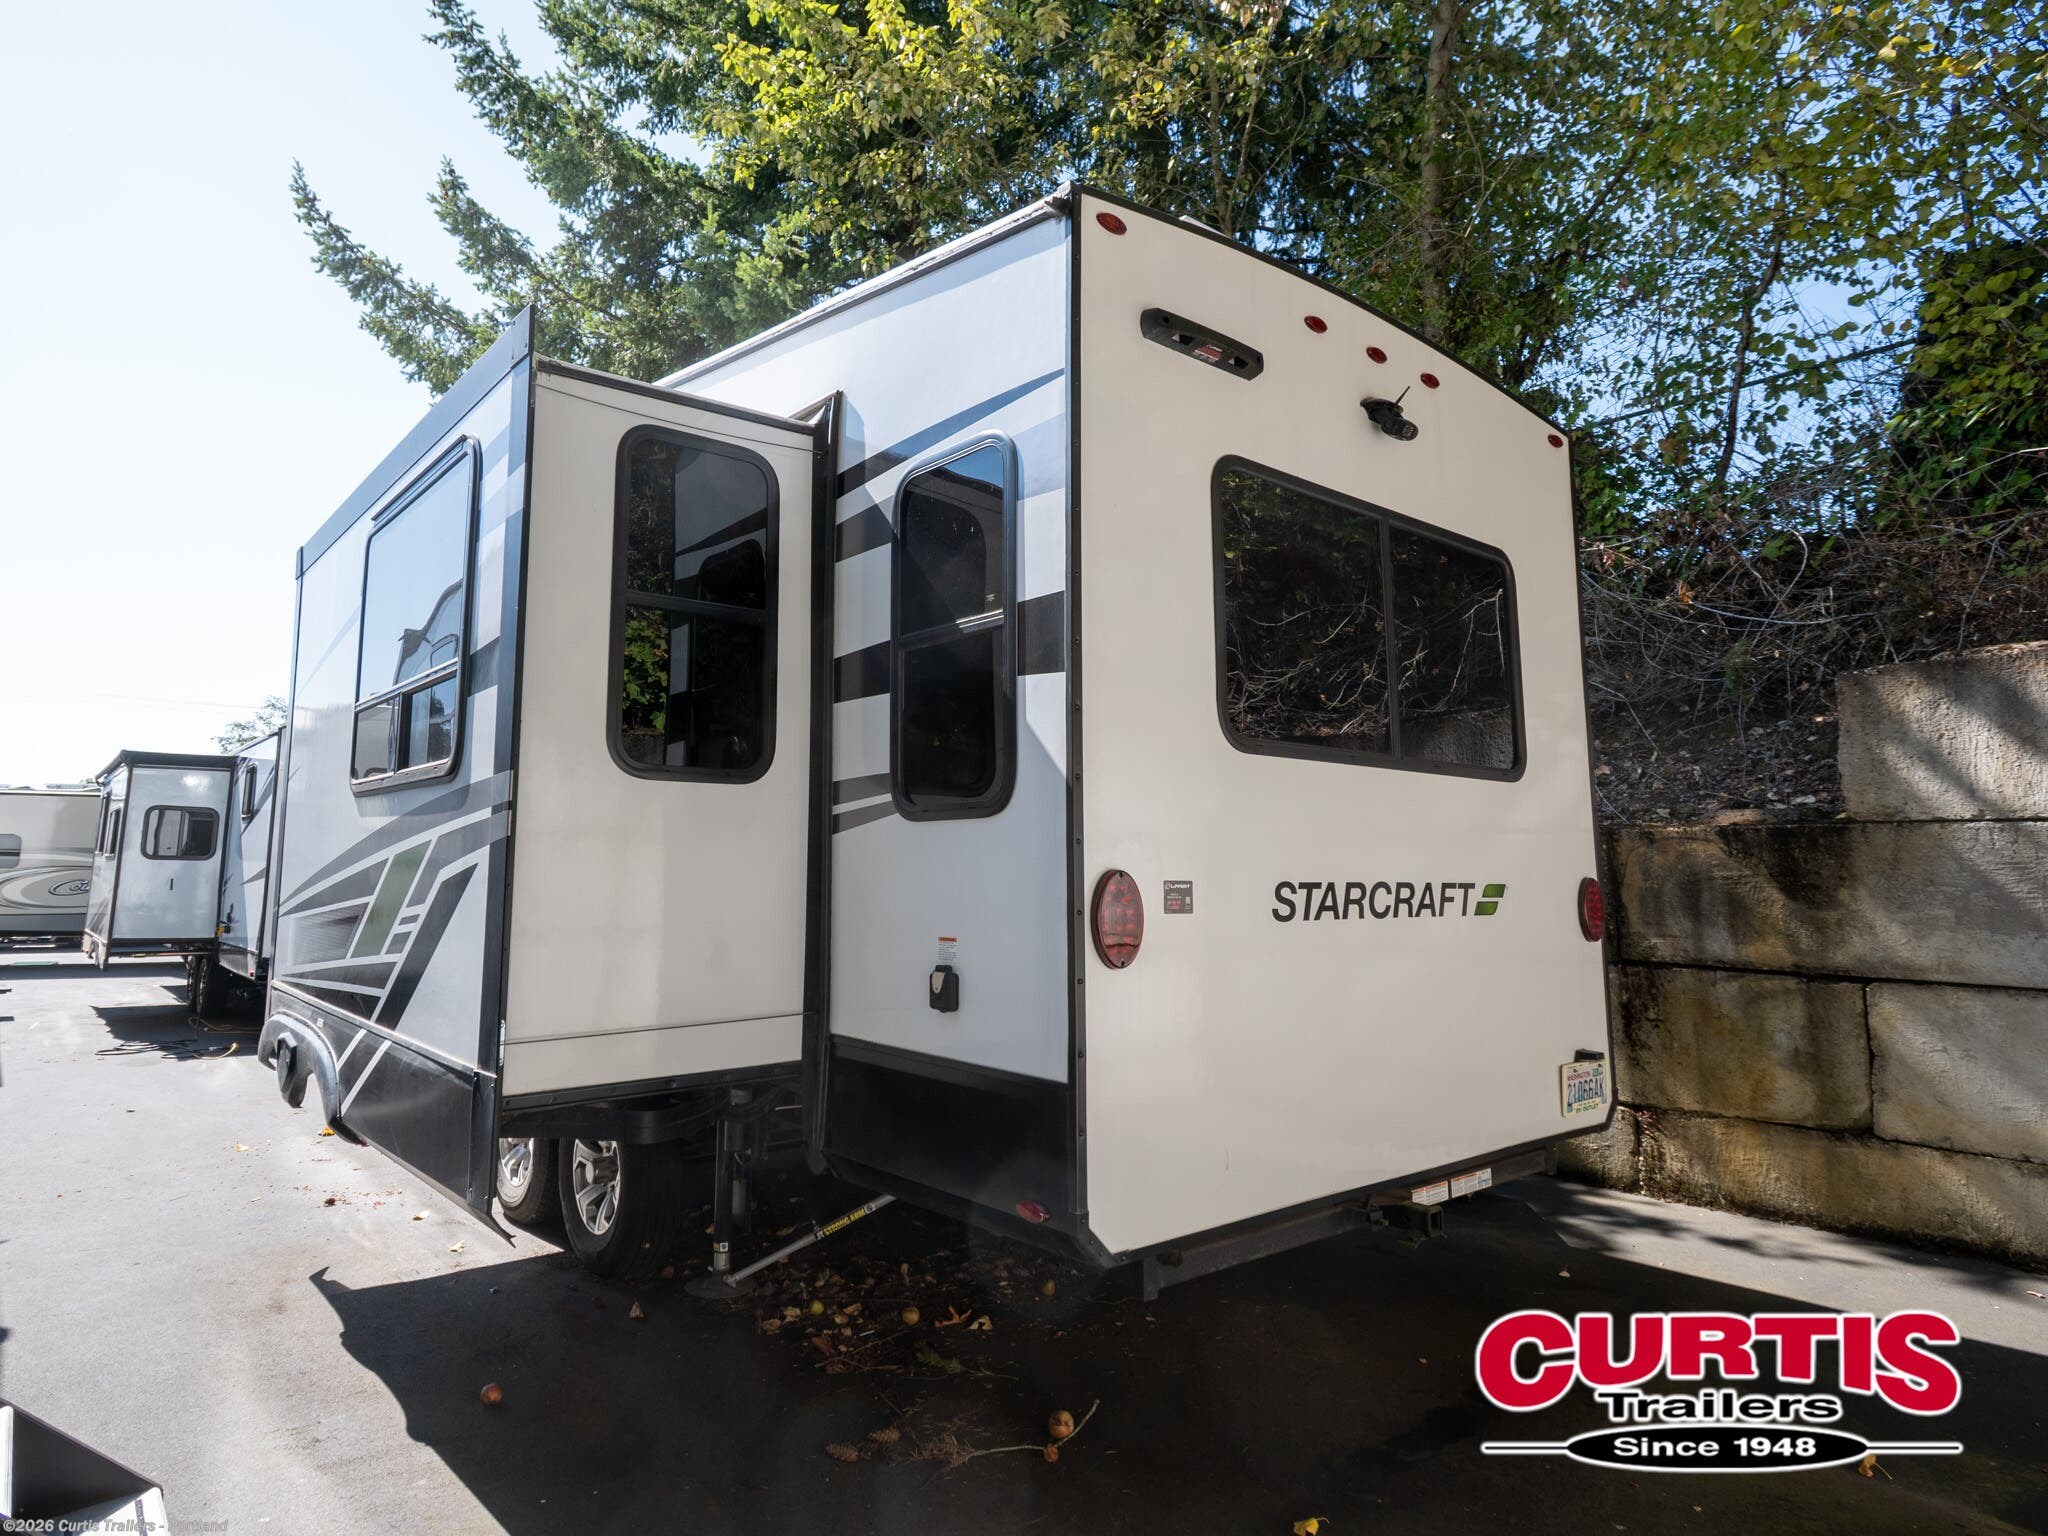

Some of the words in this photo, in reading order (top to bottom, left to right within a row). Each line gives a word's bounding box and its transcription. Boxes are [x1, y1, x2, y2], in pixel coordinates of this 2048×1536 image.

[1272, 881, 1476, 922] STARCRAFT
[823, 1216, 851, 1236] STRONG
[850, 1208, 866, 1222] ARM
